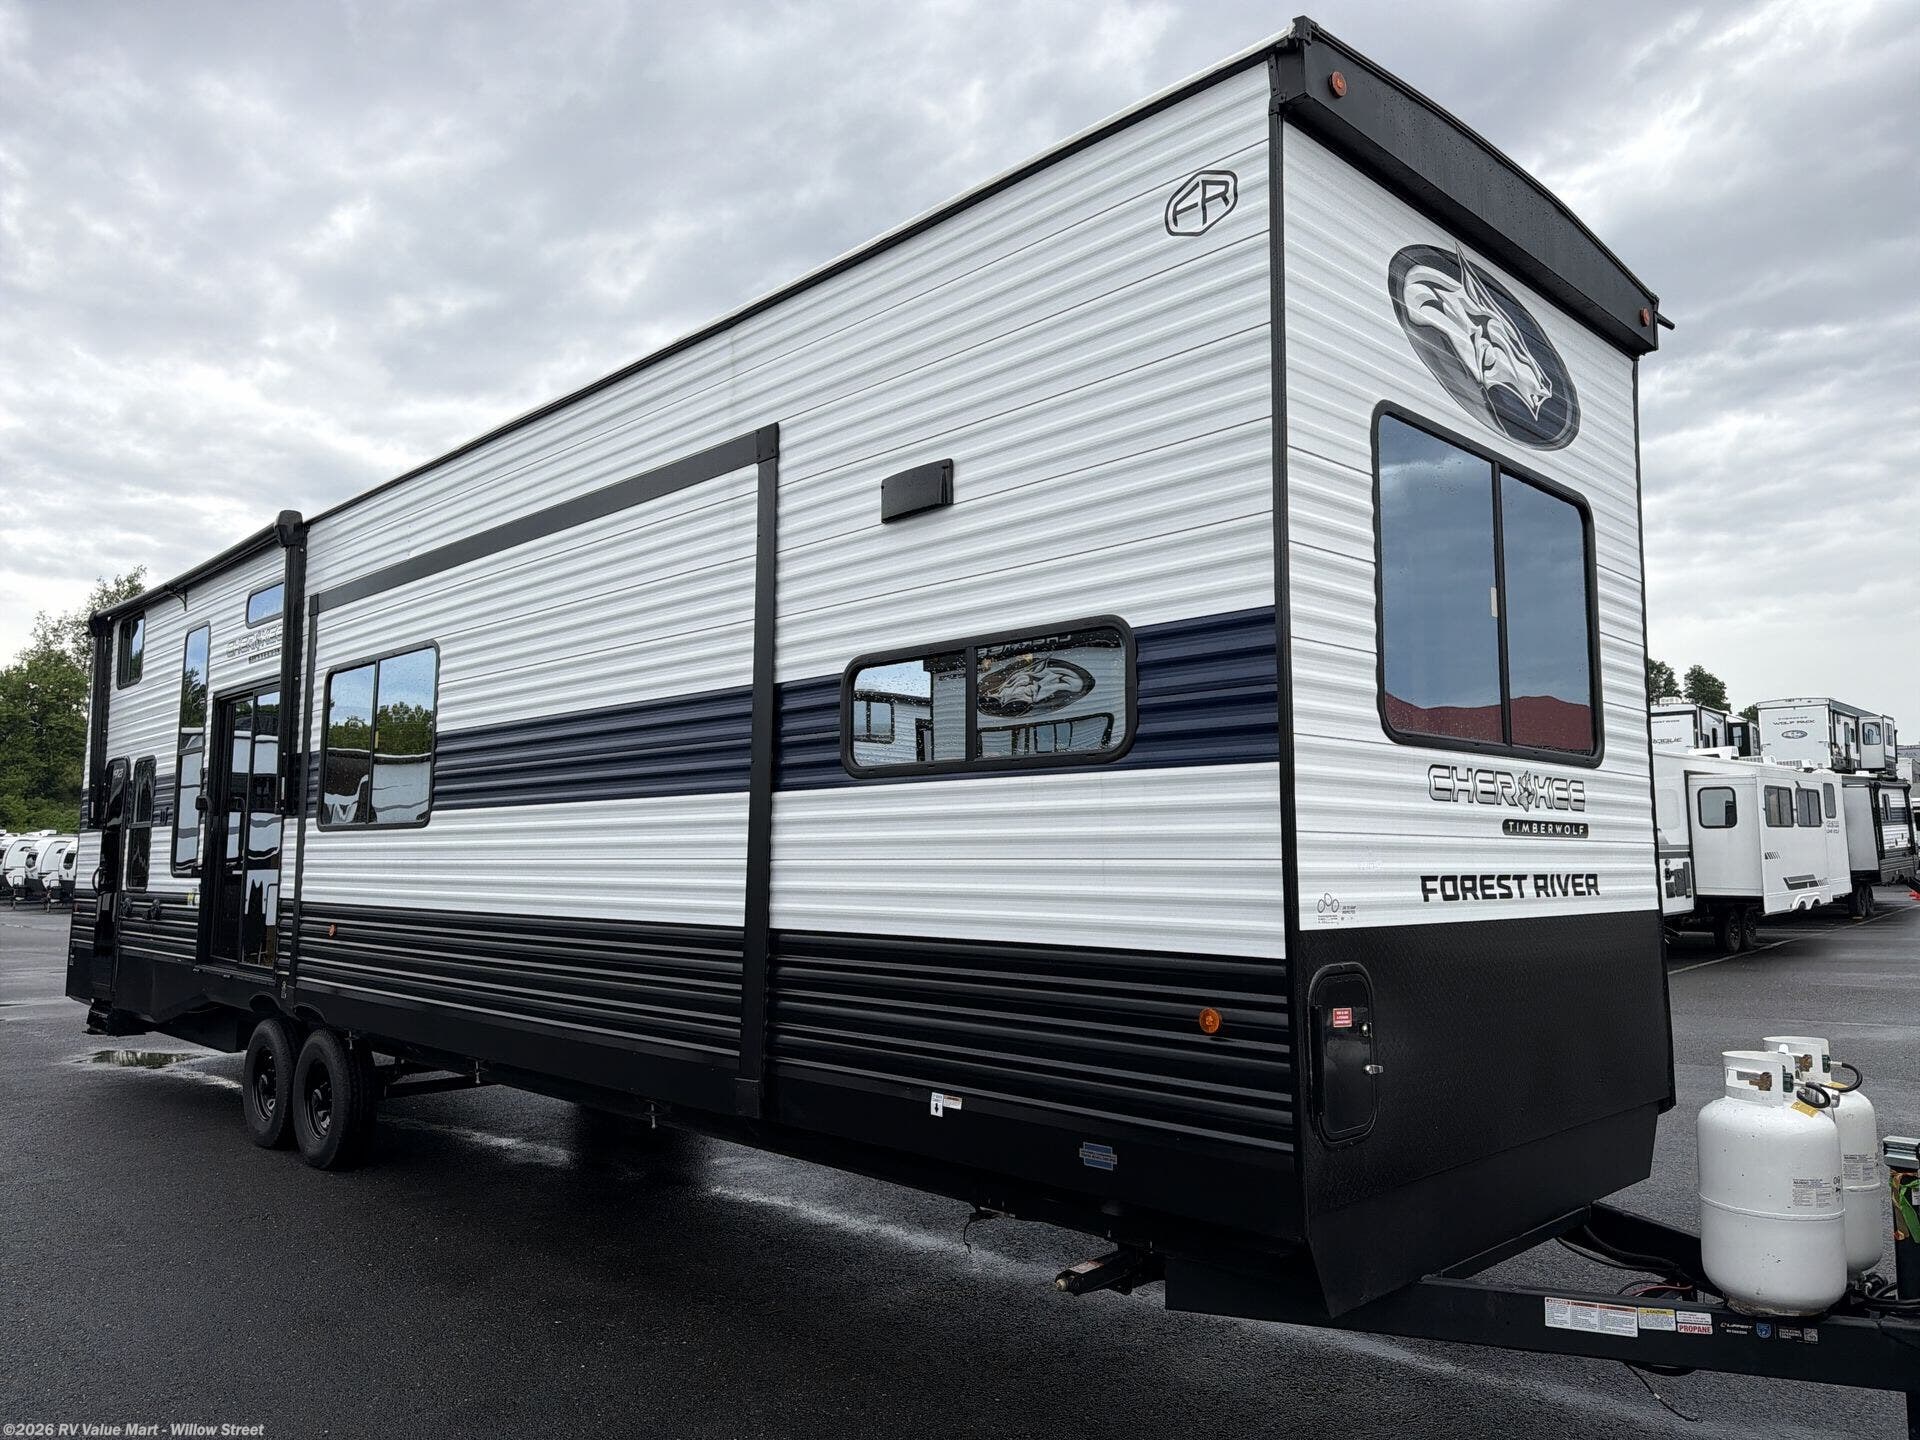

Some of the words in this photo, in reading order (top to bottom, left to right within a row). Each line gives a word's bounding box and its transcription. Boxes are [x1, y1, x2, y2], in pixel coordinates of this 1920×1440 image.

[1428, 763, 1586, 812] CHEROKEE
[1508, 821, 1585, 836] TIMBERWOLF
[1420, 874, 1528, 902] FOREST
[1533, 873, 1600, 898] RIVER
[1679, 1324, 1712, 1334] PROPANE
